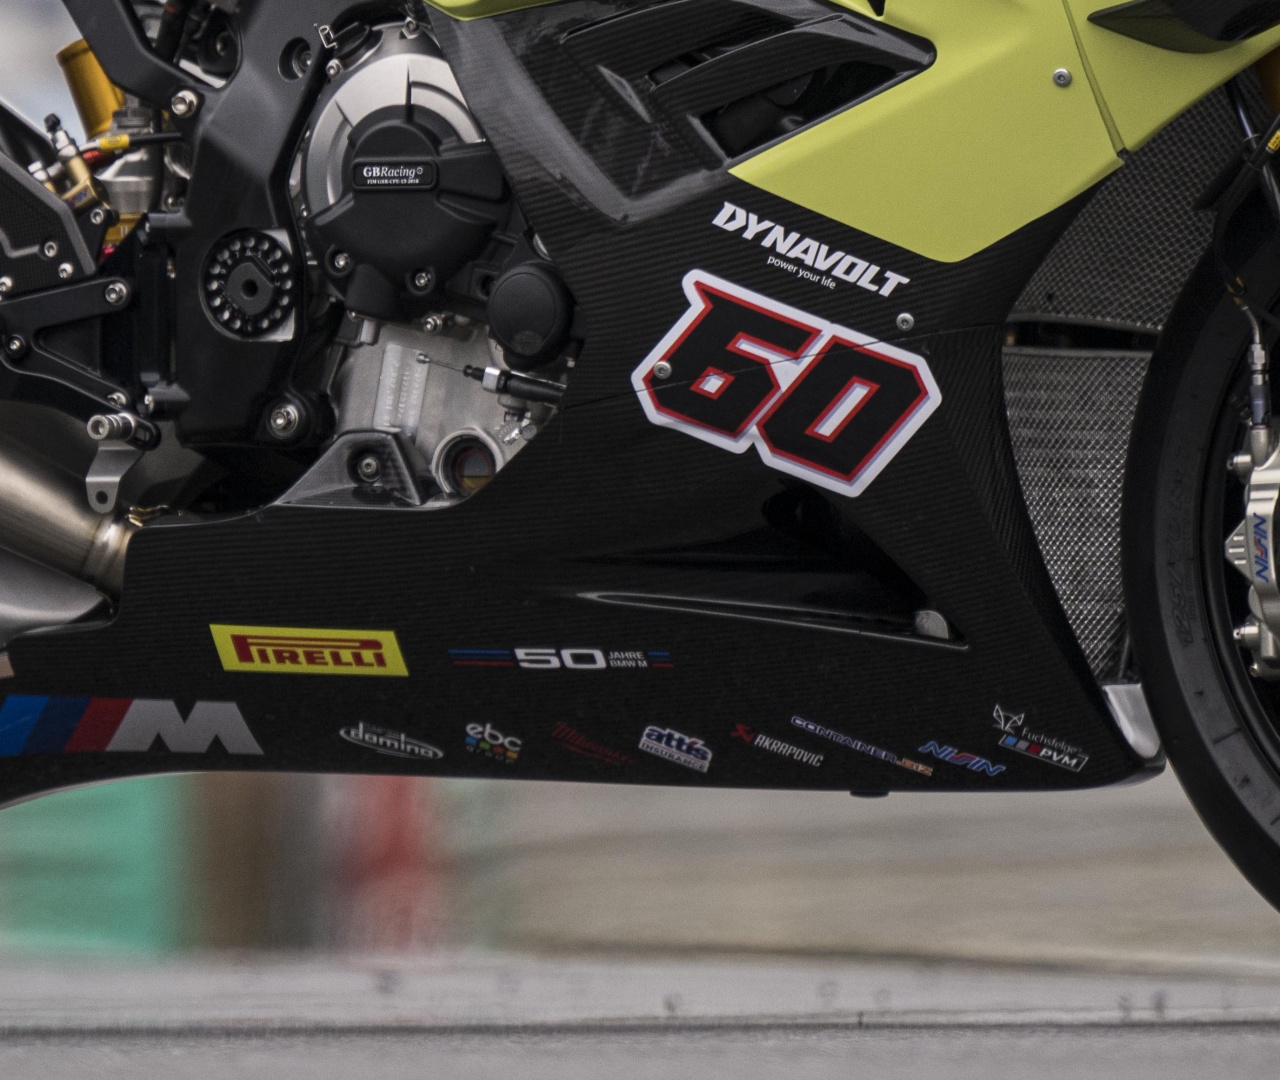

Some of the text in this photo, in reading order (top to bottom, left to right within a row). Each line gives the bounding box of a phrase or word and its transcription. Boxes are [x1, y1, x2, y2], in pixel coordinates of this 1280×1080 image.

[712, 201, 910, 297] DYNAVOLT
[767, 255, 836, 289] power your life
[641, 279, 930, 488] 60
[231, 635, 387, 668] PIRELLI
[514, 648, 607, 669] 50
[609, 651, 645, 660] JAHRE
[610, 660, 648, 668] BMW M
[350, 721, 433, 758] domino
[466, 723, 522, 751] ebc
[645, 727, 711, 762] attis
[1022, 727, 1077, 755] Fuchsfelge
[640, 742, 708, 772] INSURANCE
[1040, 747, 1078, 768] PVM
